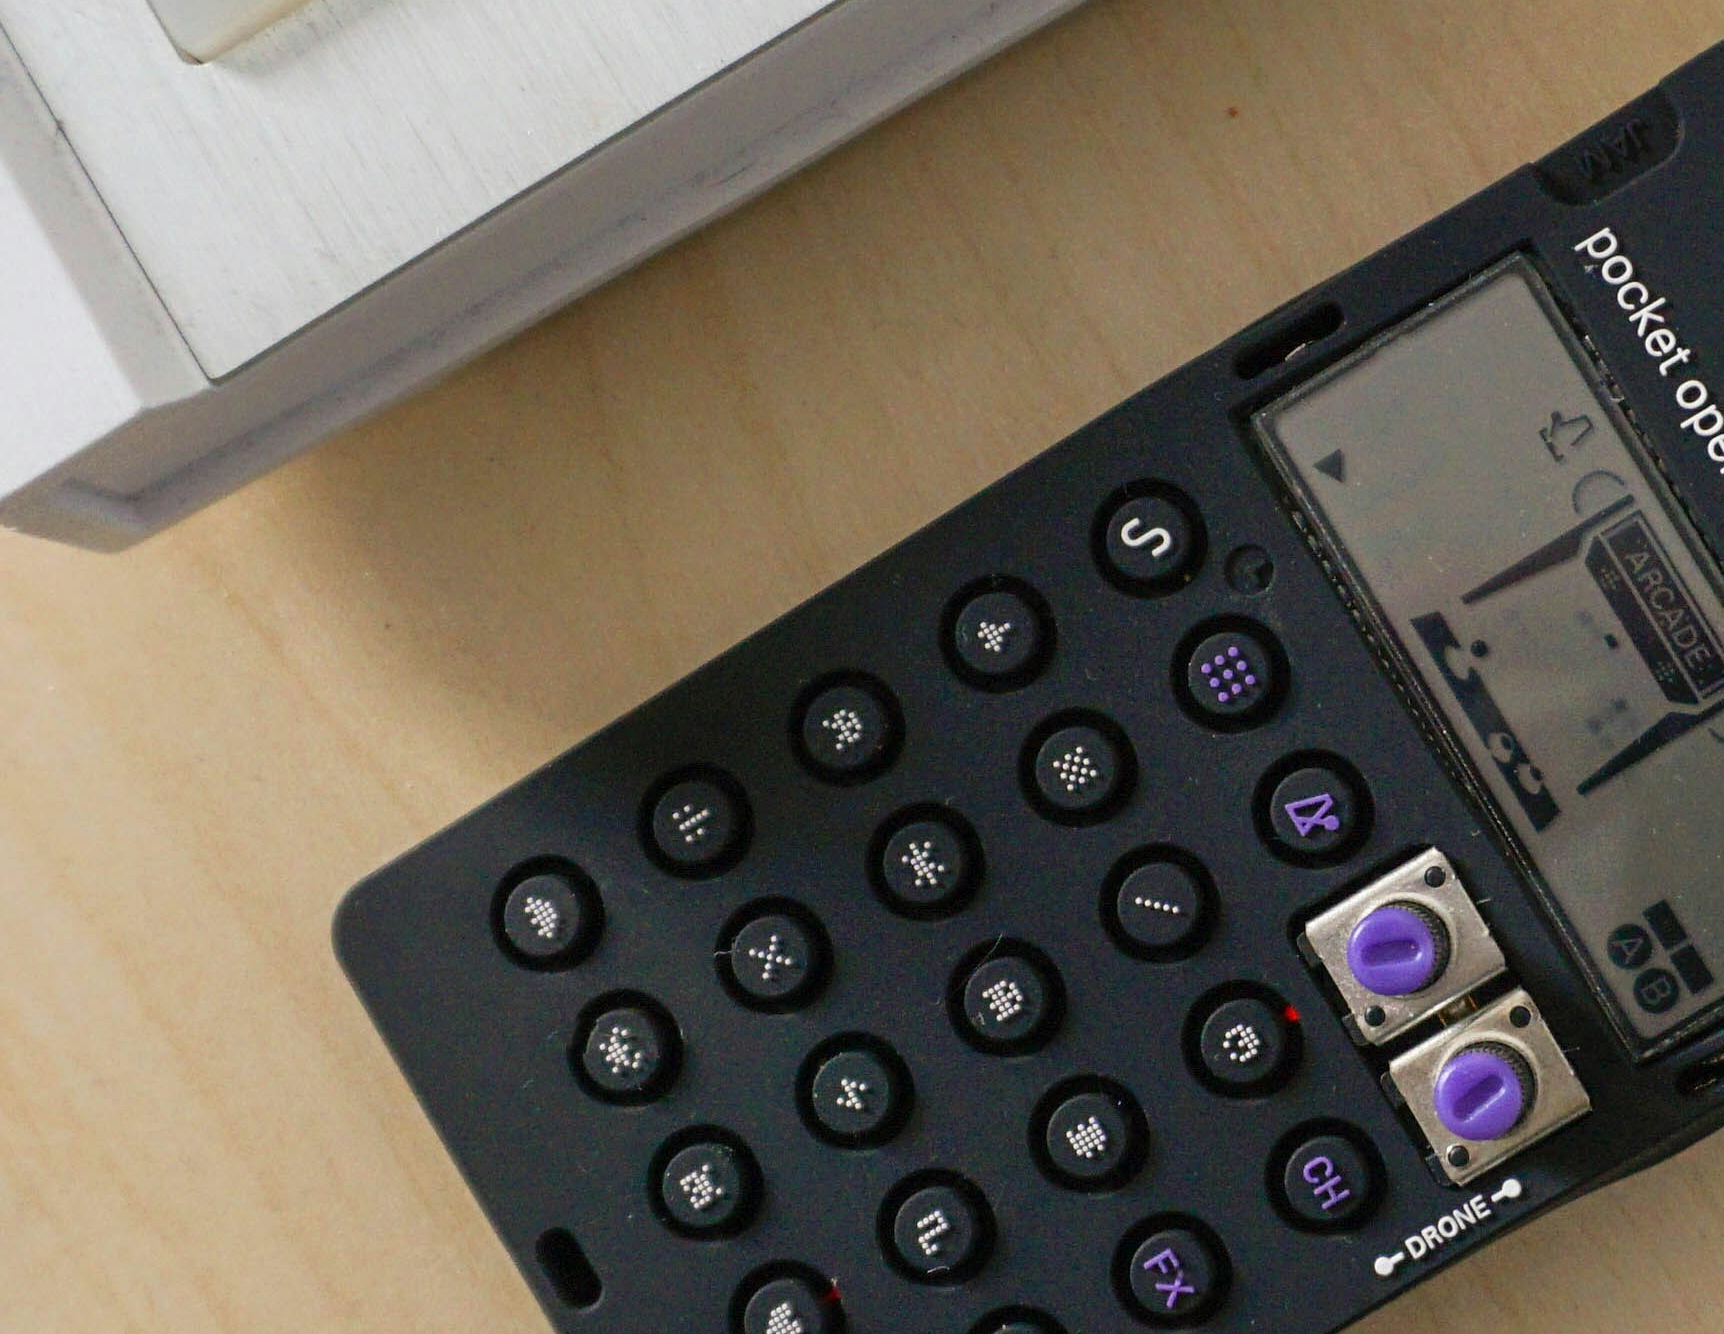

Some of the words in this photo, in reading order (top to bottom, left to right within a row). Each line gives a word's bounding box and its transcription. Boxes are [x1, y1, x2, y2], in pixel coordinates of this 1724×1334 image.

[1574, 226, 1691, 377] pocket
[1625, 551, 1711, 672] ARCADE
[1303, 1156, 1350, 1210] CH
[1403, 1194, 1492, 1261] DRONE
[1143, 1248, 1195, 1308] FX
